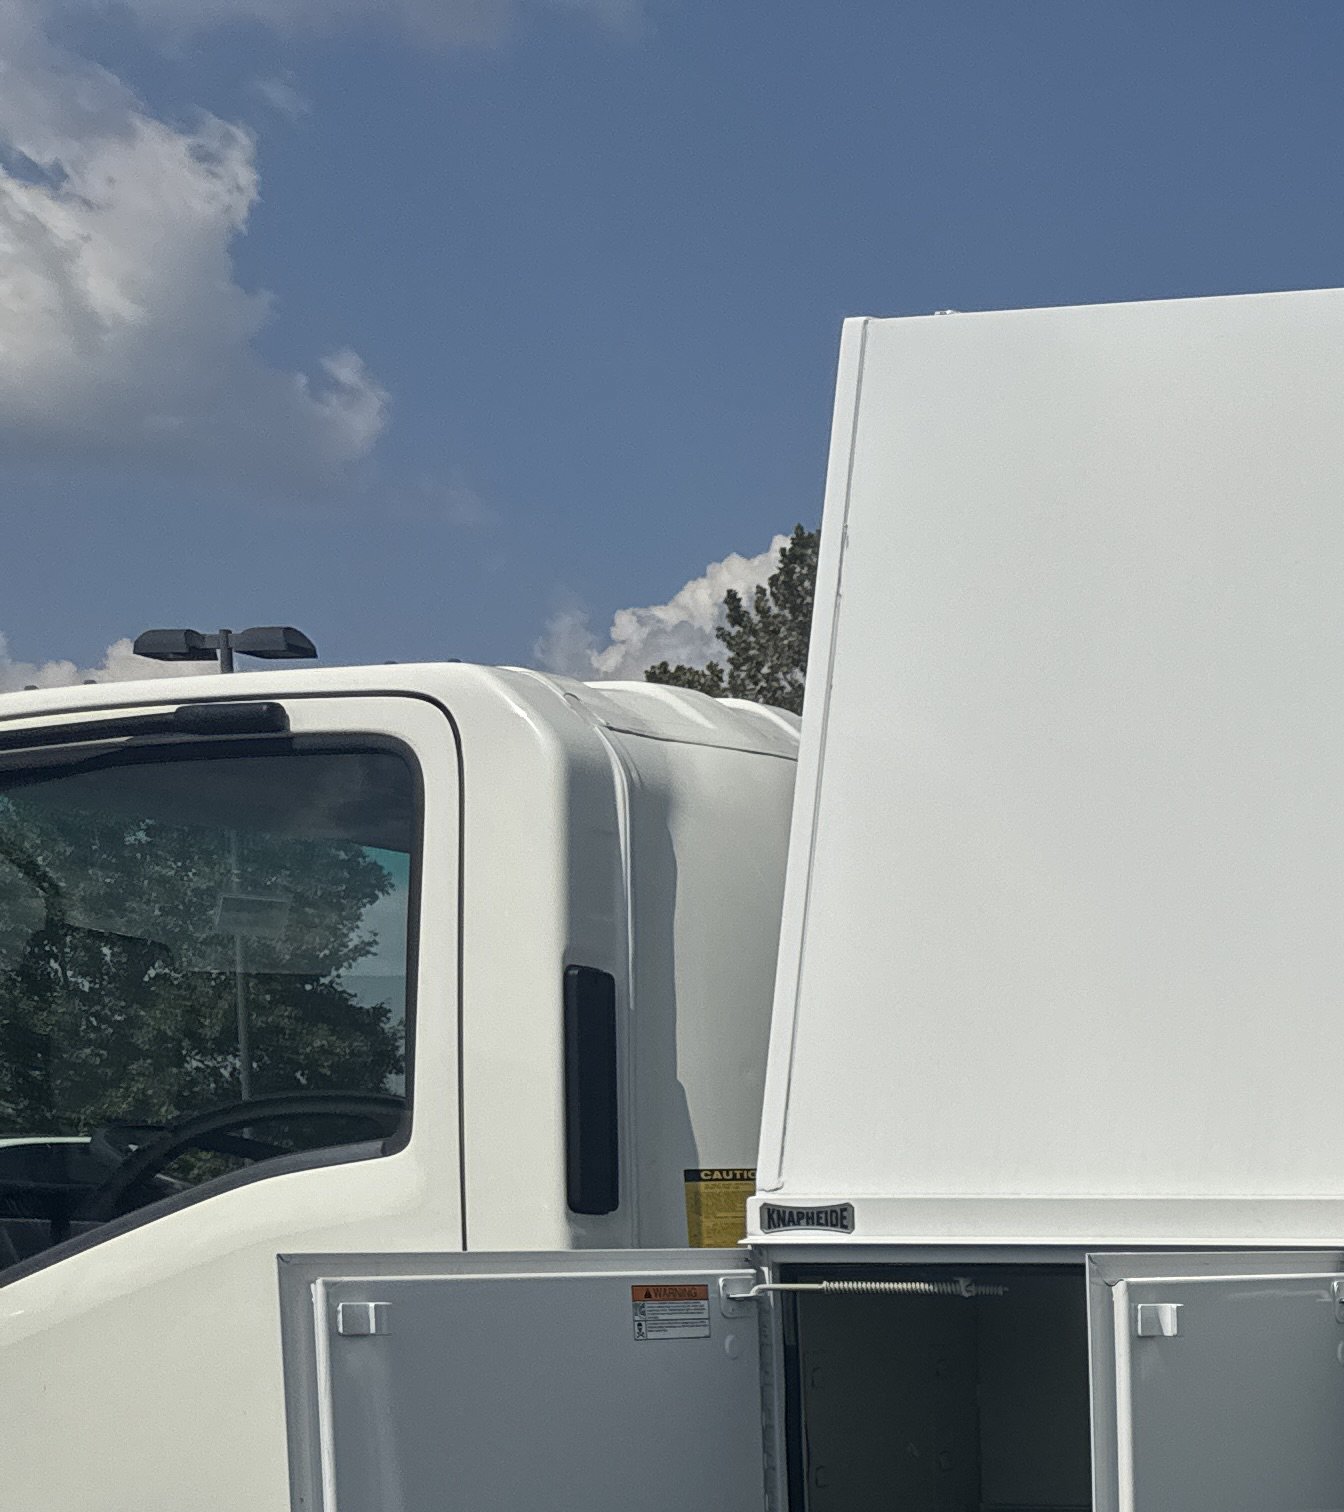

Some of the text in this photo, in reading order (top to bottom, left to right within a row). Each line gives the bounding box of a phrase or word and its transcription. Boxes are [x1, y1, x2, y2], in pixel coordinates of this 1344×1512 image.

[700, 1170, 757, 1180] CAUTIO
[766, 1207, 849, 1230] KNAPHEIDE
[653, 1287, 698, 1299] WARNING
